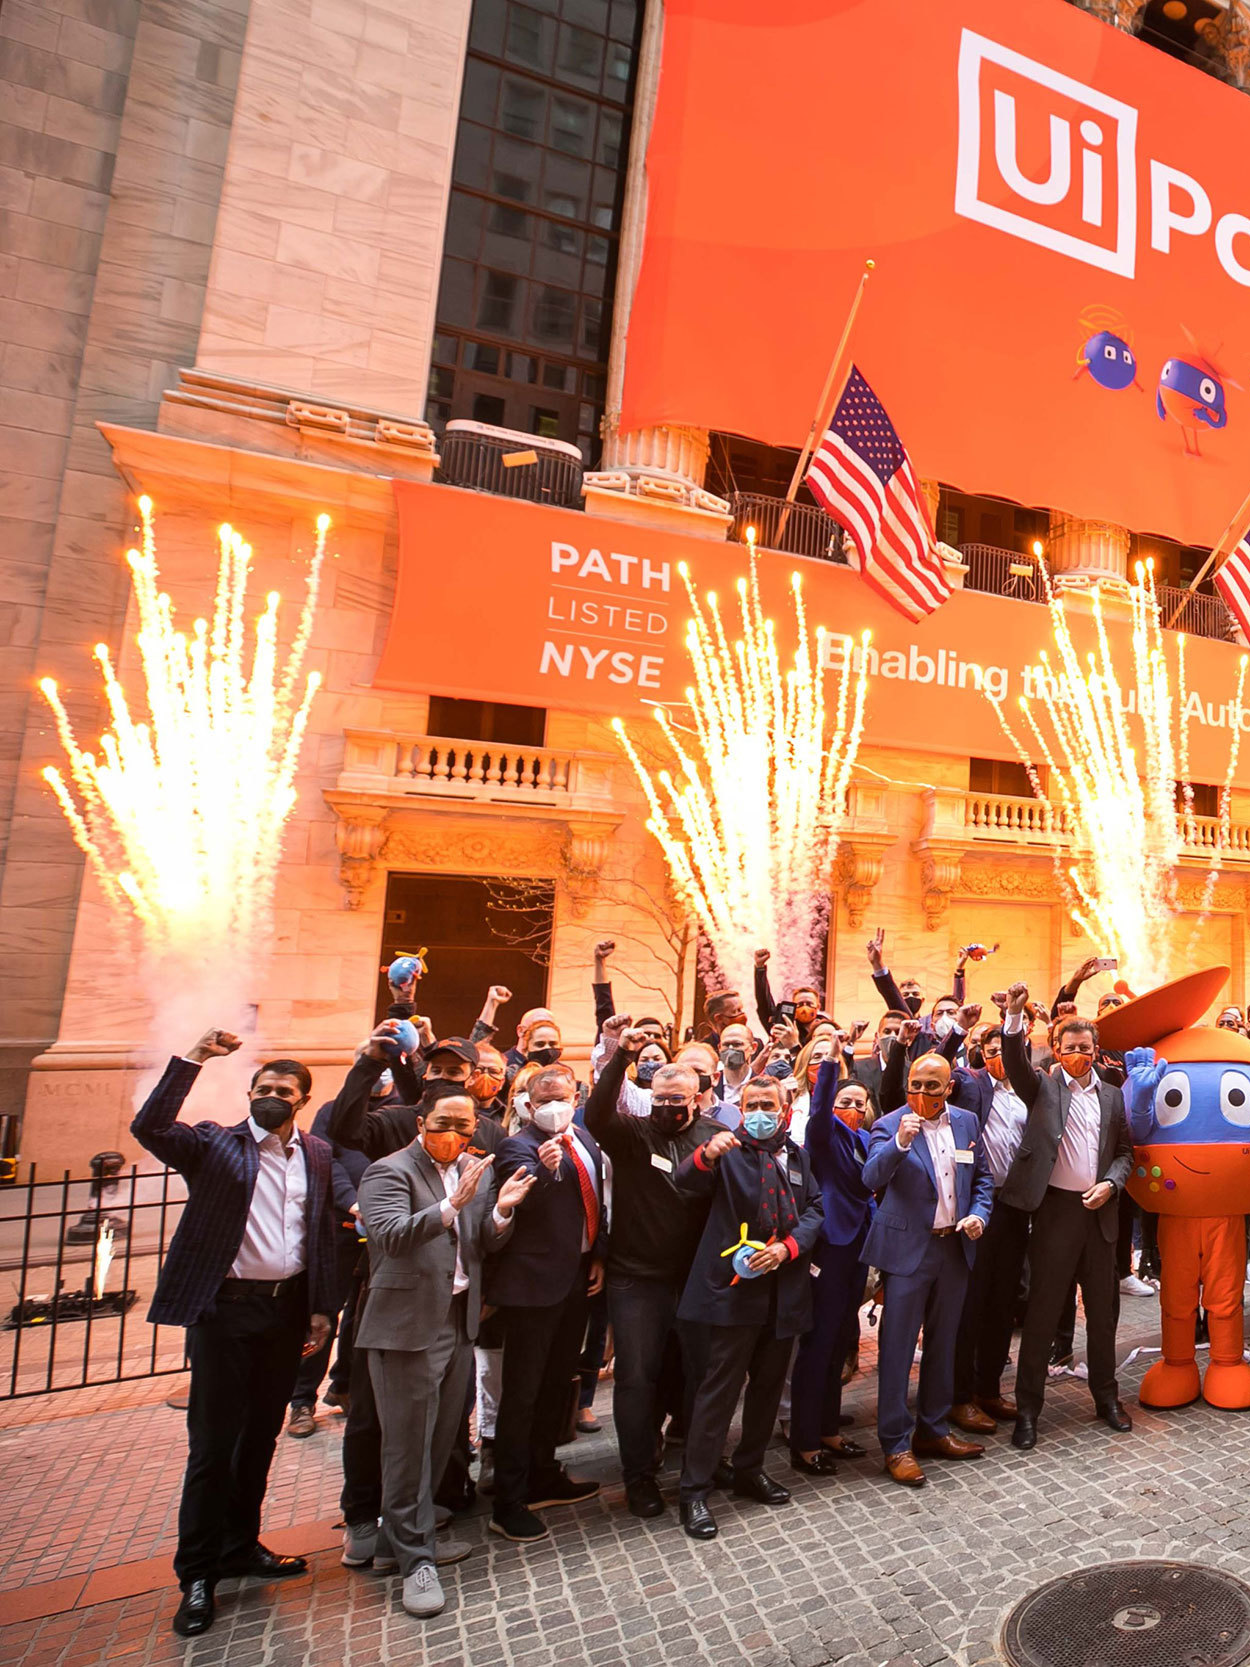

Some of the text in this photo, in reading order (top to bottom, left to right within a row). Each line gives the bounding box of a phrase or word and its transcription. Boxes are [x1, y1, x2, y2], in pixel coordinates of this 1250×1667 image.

[551, 541, 670, 592] PATH
[548, 596, 668, 634] LISTED
[539, 641, 664, 688] NYSE
[822, 631, 1009, 702] Enabling
